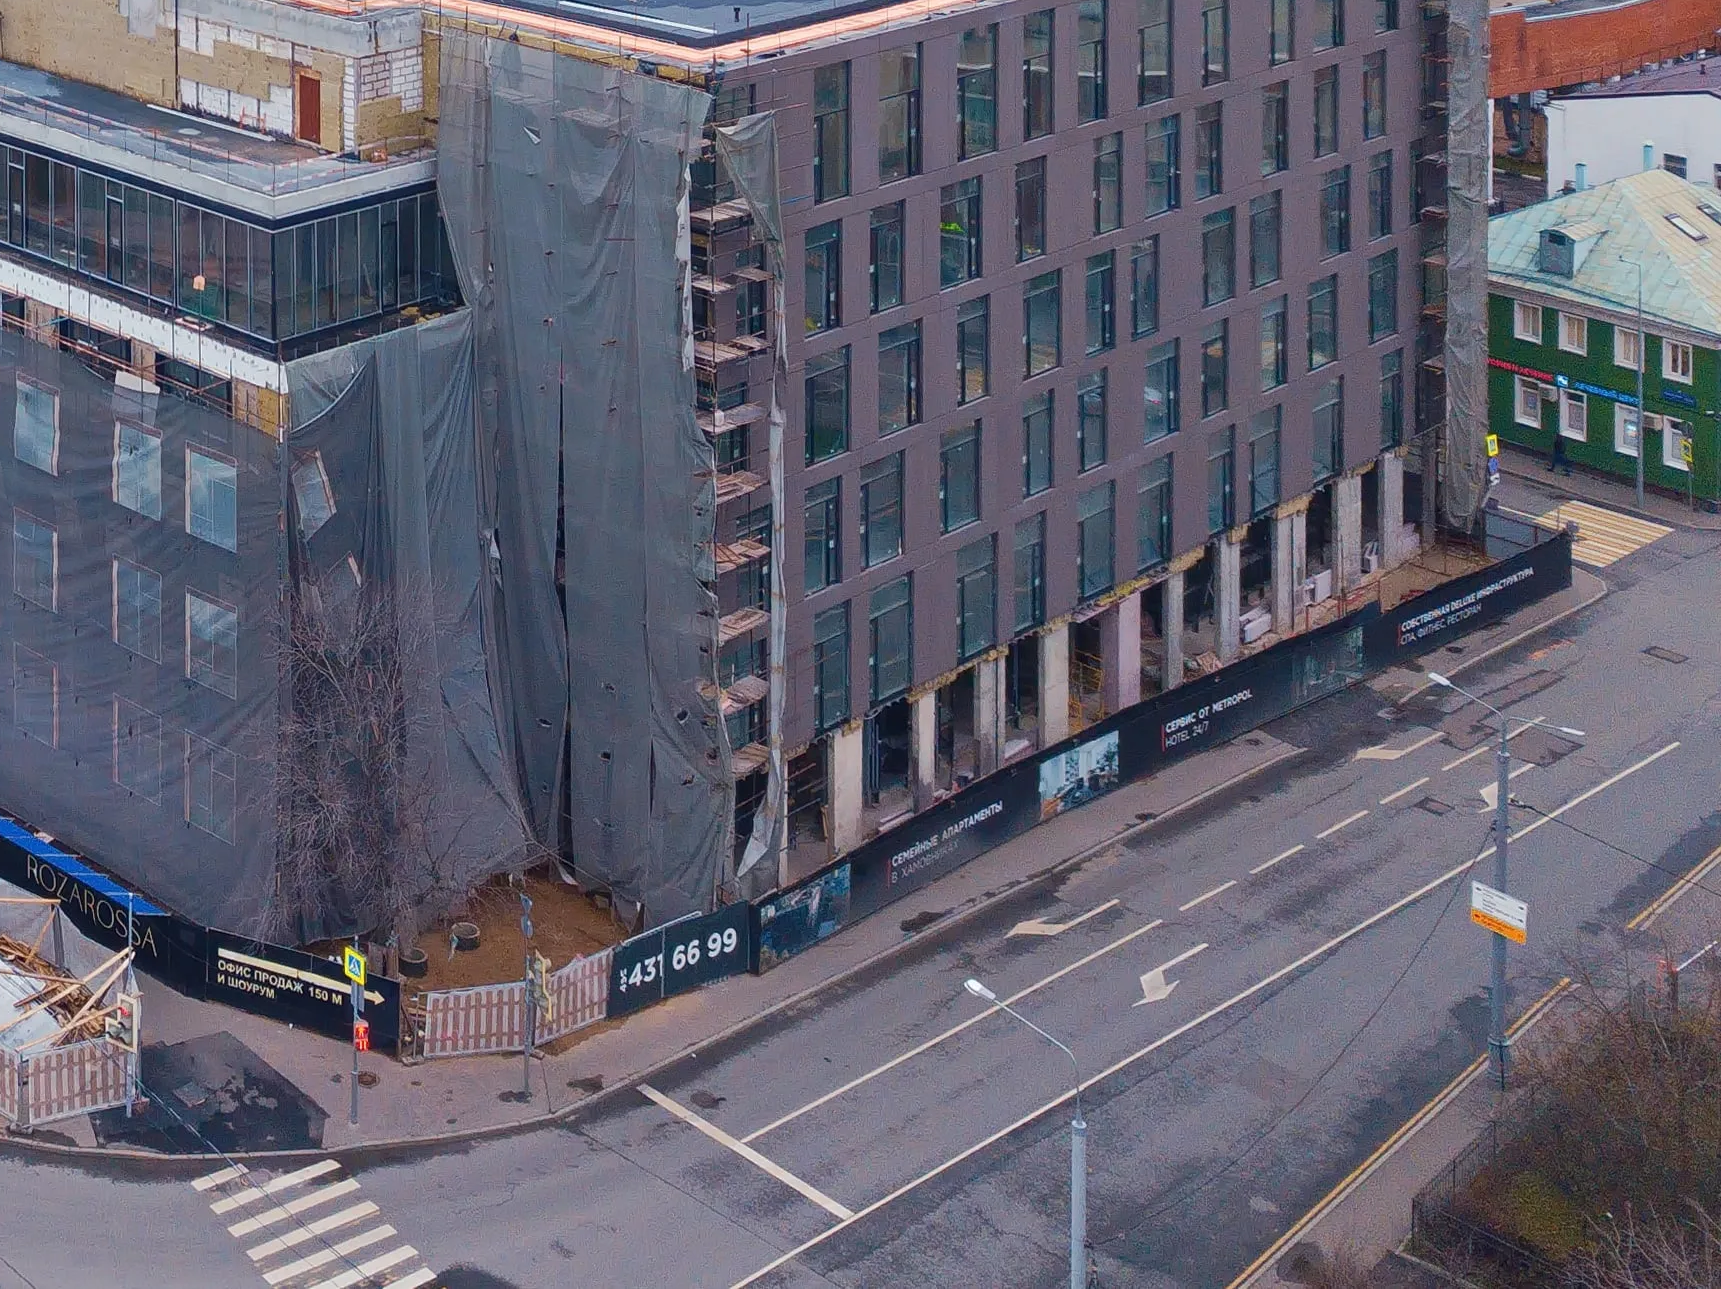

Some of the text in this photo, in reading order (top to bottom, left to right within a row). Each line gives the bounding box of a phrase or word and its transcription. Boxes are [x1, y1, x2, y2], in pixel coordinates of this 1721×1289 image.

[1165, 688, 1254, 733] СЕРВИС ОТ METROPOL
[1165, 730, 1190, 748] HOTEL
[891, 799, 1003, 867] СЕМЕЙНЫЕ АПАРТАМЕНТЫ
[891, 871, 898, 883] В
[27, 854, 157, 958] ROZAROSSA
[629, 927, 737, 987] 431 66 99
[217, 973, 275, 1000] И ШОУРУМ
[218, 959, 252, 979] ОФИС
[254, 971, 304, 995] ПРОДАЖ
[308, 986, 329, 1002] 150
